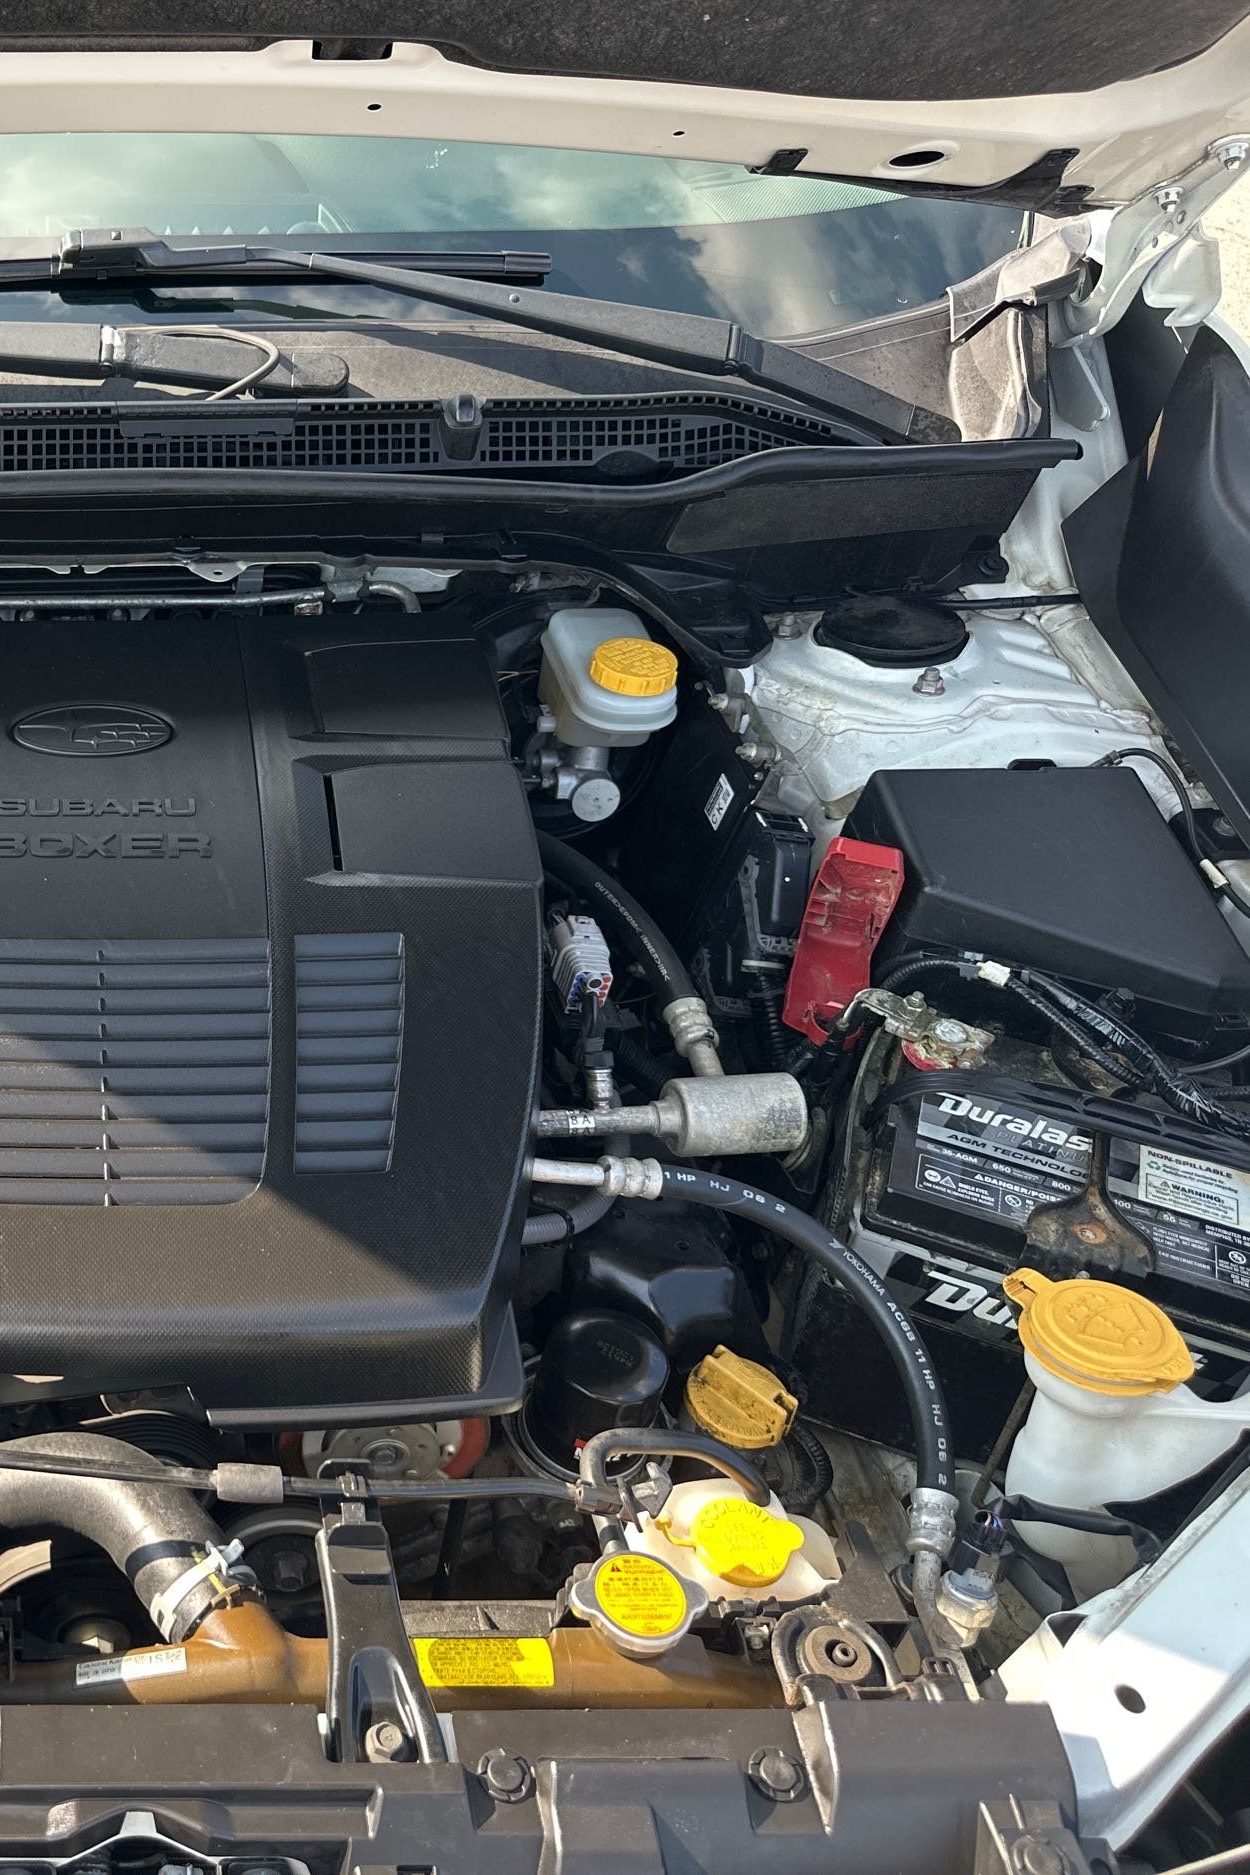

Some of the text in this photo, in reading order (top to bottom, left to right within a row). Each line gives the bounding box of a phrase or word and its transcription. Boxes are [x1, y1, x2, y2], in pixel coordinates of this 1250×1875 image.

[937, 1092, 1093, 1153] Duralas
[946, 1133, 987, 1149] AGM
[996, 1131, 1085, 1163] PLATINU
[942, 1148, 978, 1164] 35-AGM
[1147, 1150, 1233, 1179] NON-SPILLABLE
[992, 1163, 1011, 1173] 650
[1051, 1180, 1071, 1191] 800
[677, 1172, 696, 1182] HP
[709, 1180, 730, 1192] HJ
[774, 1203, 786, 1214] 2
[1171, 1183, 1225, 1204] WARNING:
[843, 1250, 886, 1296] YOKOHAMA
[915, 1348, 927, 1363] 11
[922, 1369, 936, 1391] HP
[931, 1404, 944, 1427] HJ
[938, 1473, 948, 1486] 2
